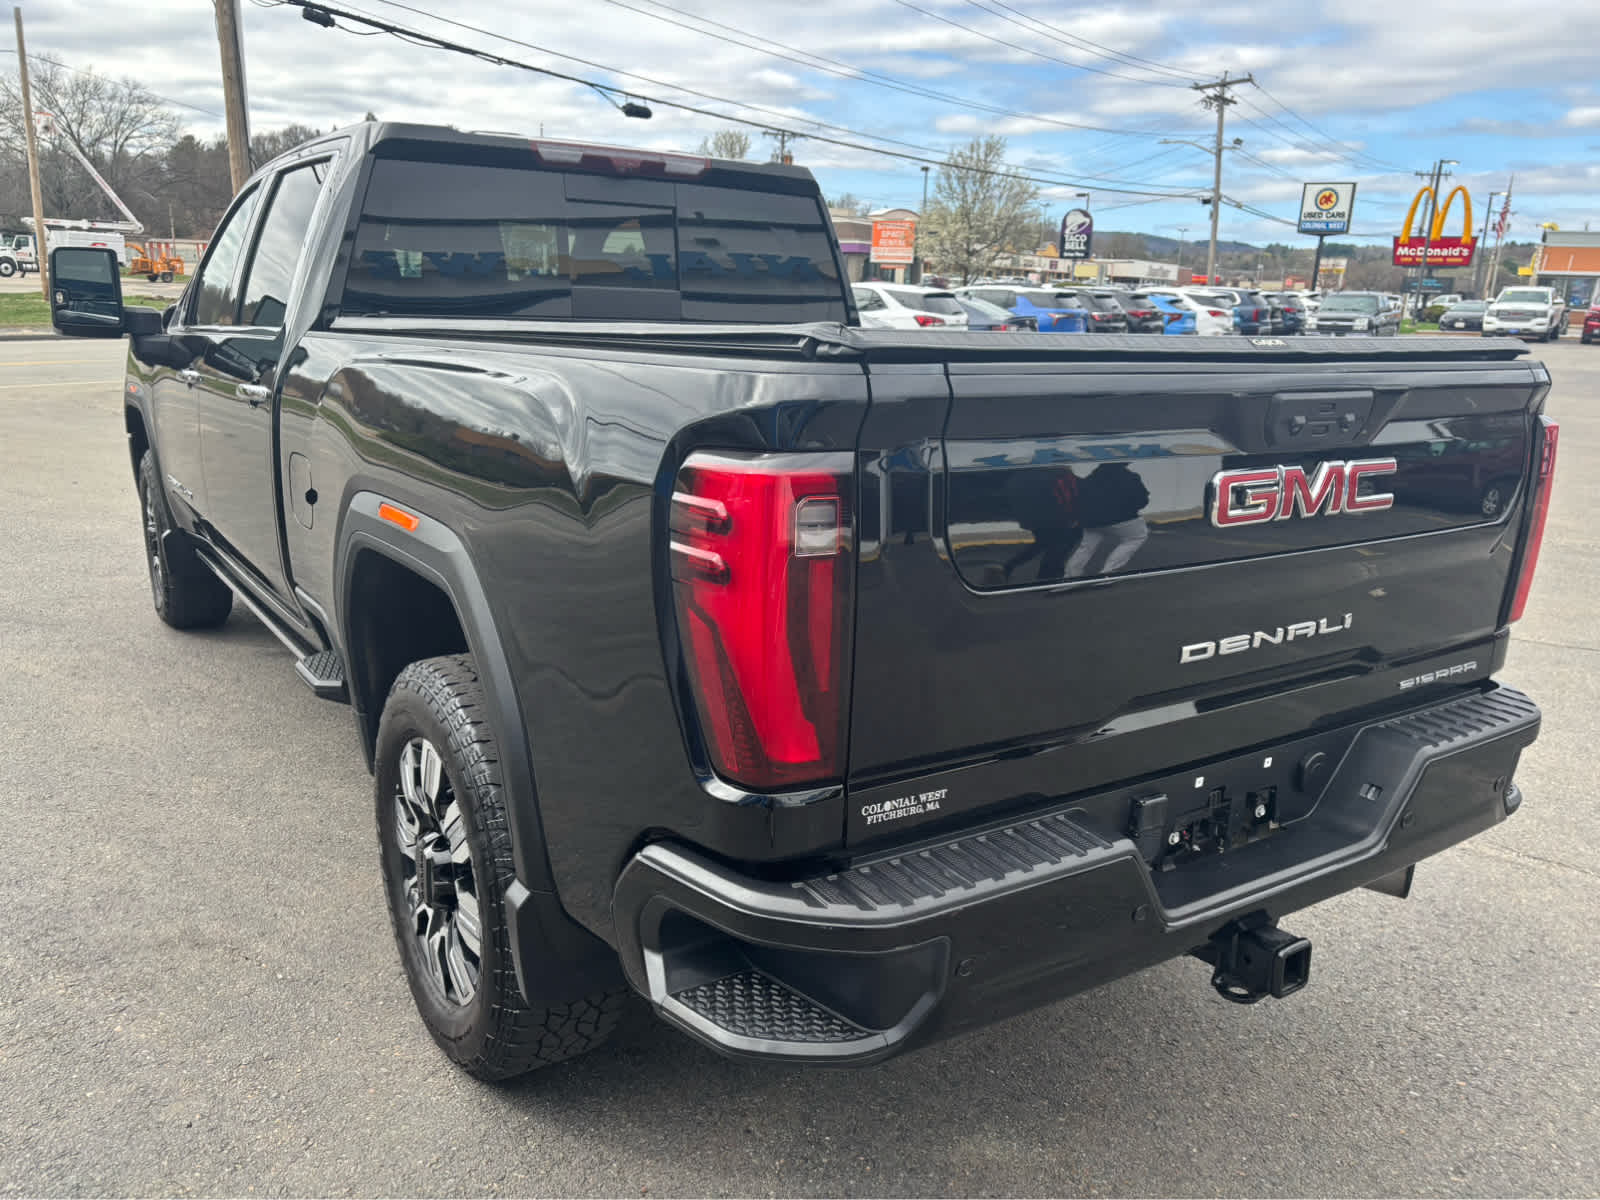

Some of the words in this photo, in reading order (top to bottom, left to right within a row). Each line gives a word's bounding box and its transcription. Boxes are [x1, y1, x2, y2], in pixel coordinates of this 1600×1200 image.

[1064, 234, 1087, 242] TACO
[1064, 241, 1086, 250] BELL
[1396, 245, 1471, 257] McDonald's
[1212, 457, 1398, 528] GMC
[1179, 612, 1353, 664] DENALI
[1399, 660, 1478, 690] SIERRA
[861, 795, 917, 816] COLONIAL
[919, 789, 948, 802] WEST
[926, 801, 940, 811] MA
